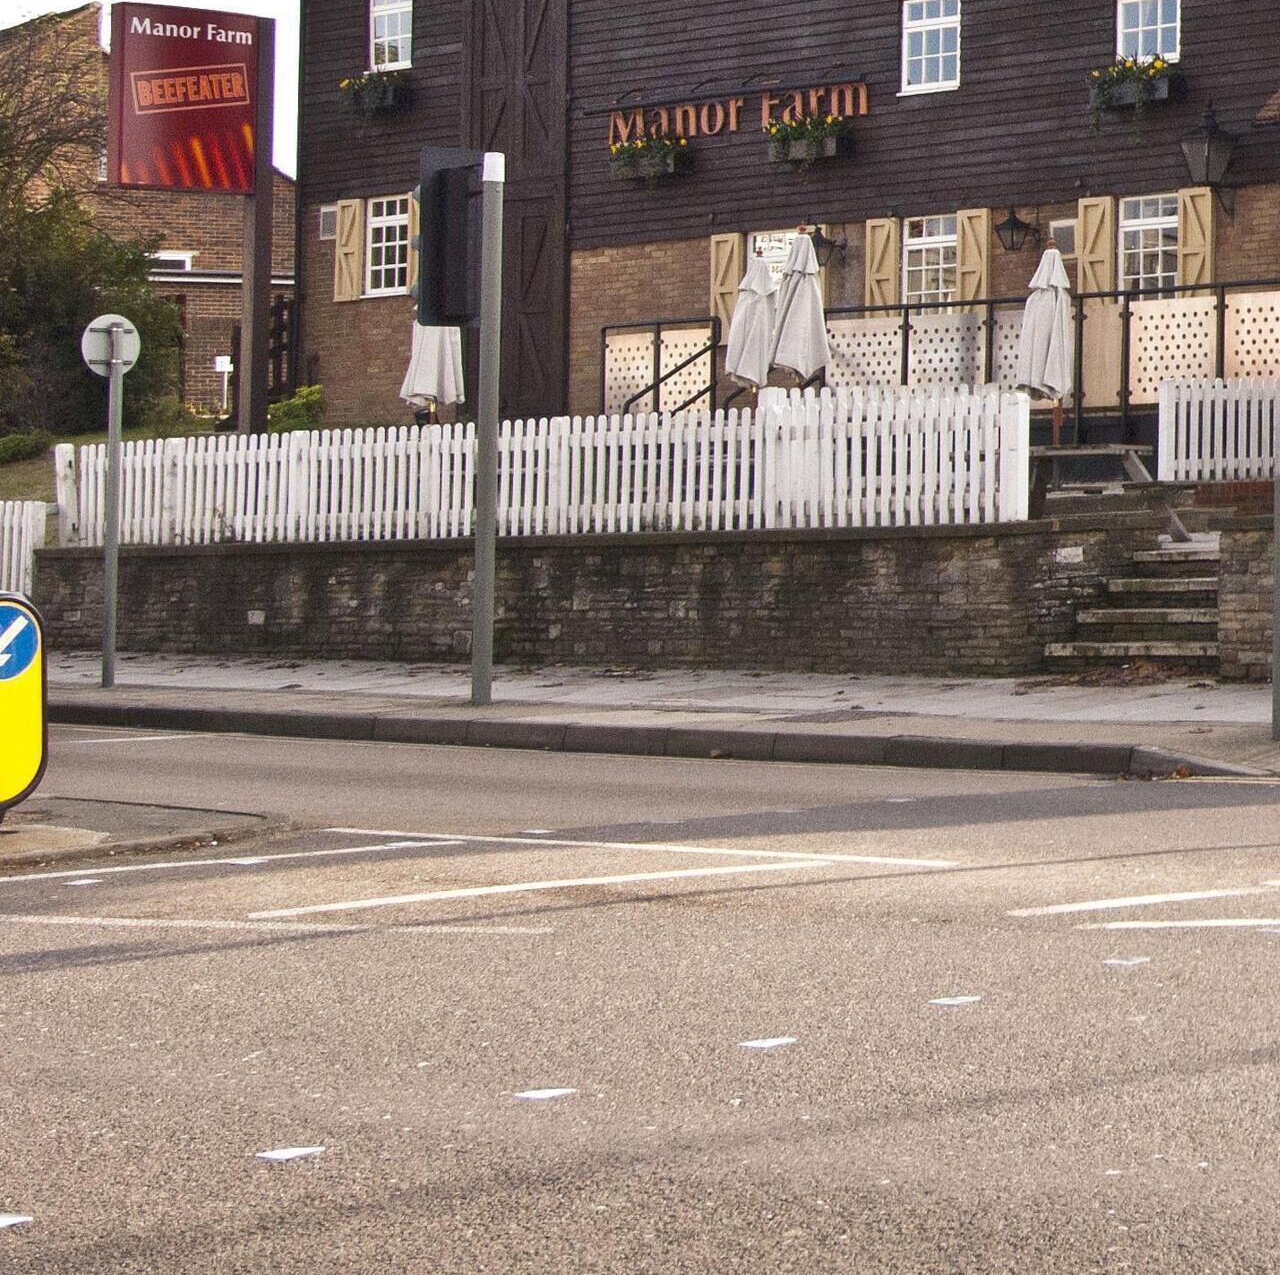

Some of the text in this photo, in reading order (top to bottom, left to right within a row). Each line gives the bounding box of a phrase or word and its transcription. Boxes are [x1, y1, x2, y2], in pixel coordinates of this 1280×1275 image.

[130, 16, 253, 45] Manor Farm
[136, 72, 245, 106] BEEFEATER
[608, 98, 745, 146] Manor
